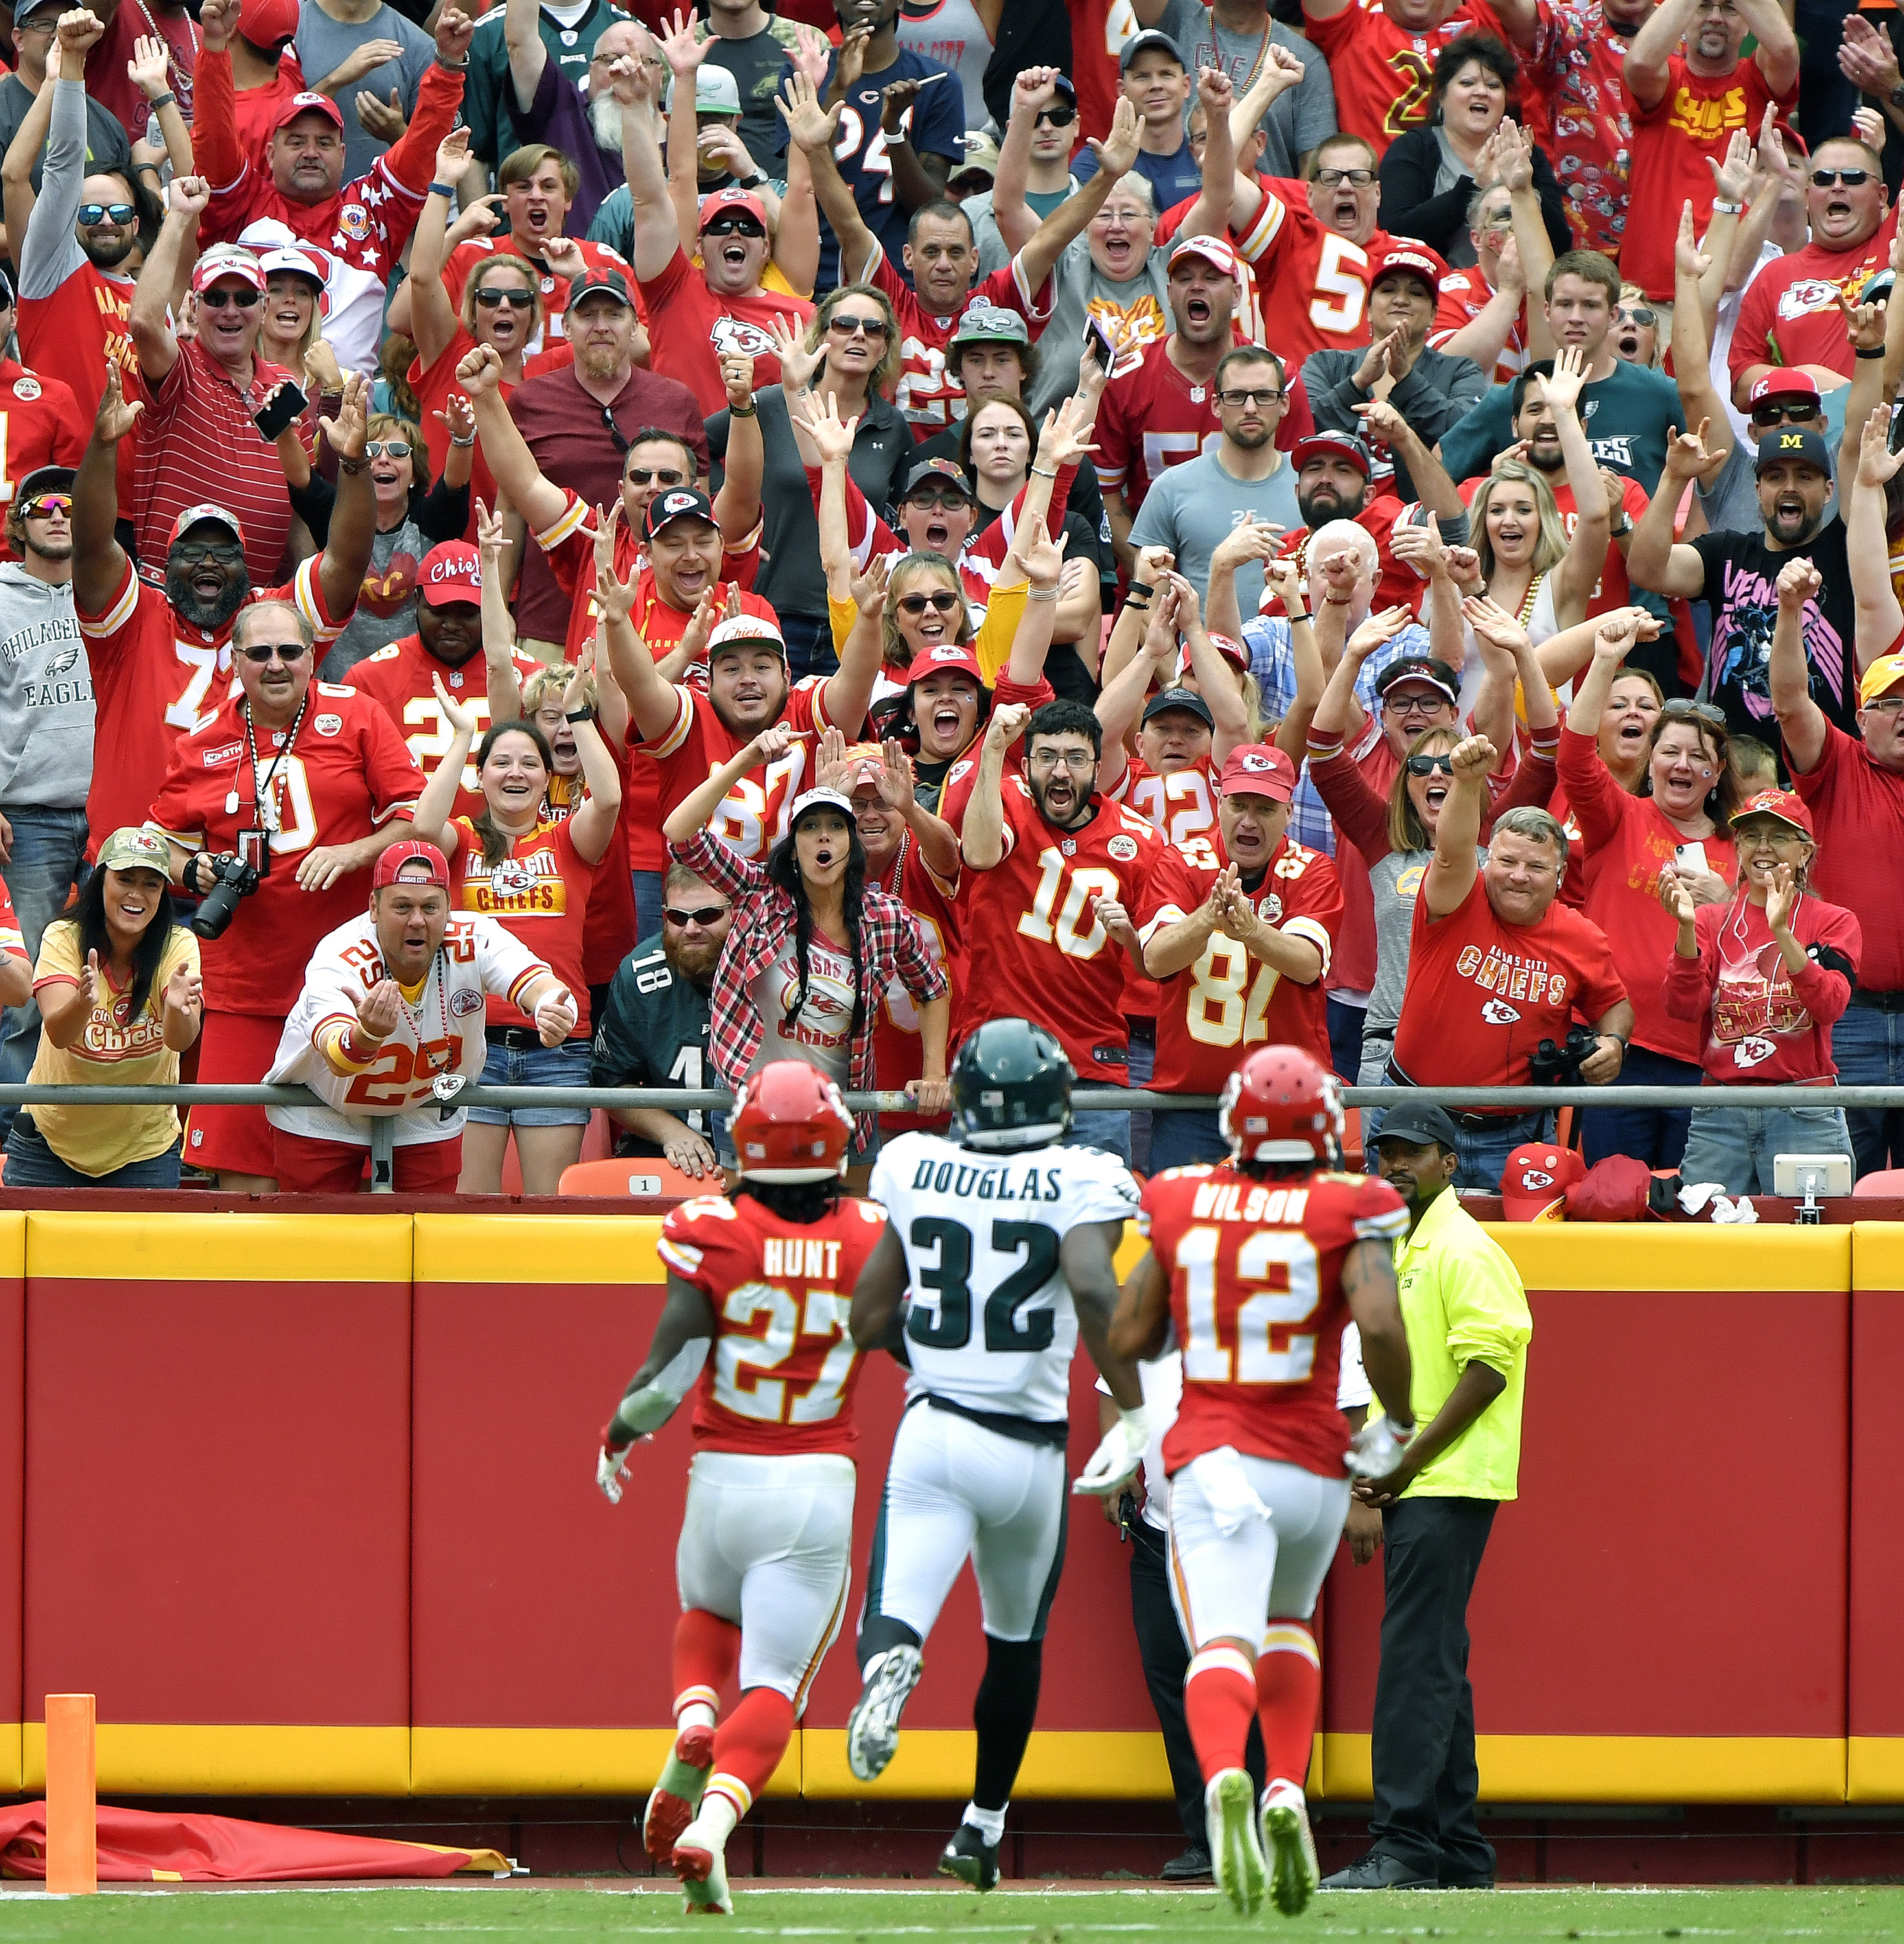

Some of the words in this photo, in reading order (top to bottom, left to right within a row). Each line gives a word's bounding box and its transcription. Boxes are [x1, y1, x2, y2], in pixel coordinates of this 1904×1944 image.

[585, 268, 610, 286] N
[1309, 230, 1366, 334] 5
[1586, 438, 1633, 467] LES
[1779, 433, 1804, 448] M
[1724, 559, 1779, 610] VEN
[1, 618, 82, 666] PHILADEL
[646, 638, 680, 649] KANS
[23, 680, 96, 707] EAGL
[524, 851, 558, 875] CITY
[476, 885, 553, 910] CHIEFS
[1015, 846, 1117, 959] 10
[630, 949, 673, 994] 18
[1456, 945, 1567, 1006] CHIEFS
[1525, 959, 1548, 972] CITY
[84, 1017, 164, 1052] Chiefs
[641, 1179, 650, 1192] 1
[912, 1159, 1063, 1203] DOUGLAS
[1192, 1183, 1310, 1223] WILSON
[764, 1238, 842, 1280] HUNT
[909, 1216, 1061, 1352] 32
[1172, 1224, 1320, 1385] 12
[713, 1281, 854, 1426] 27
